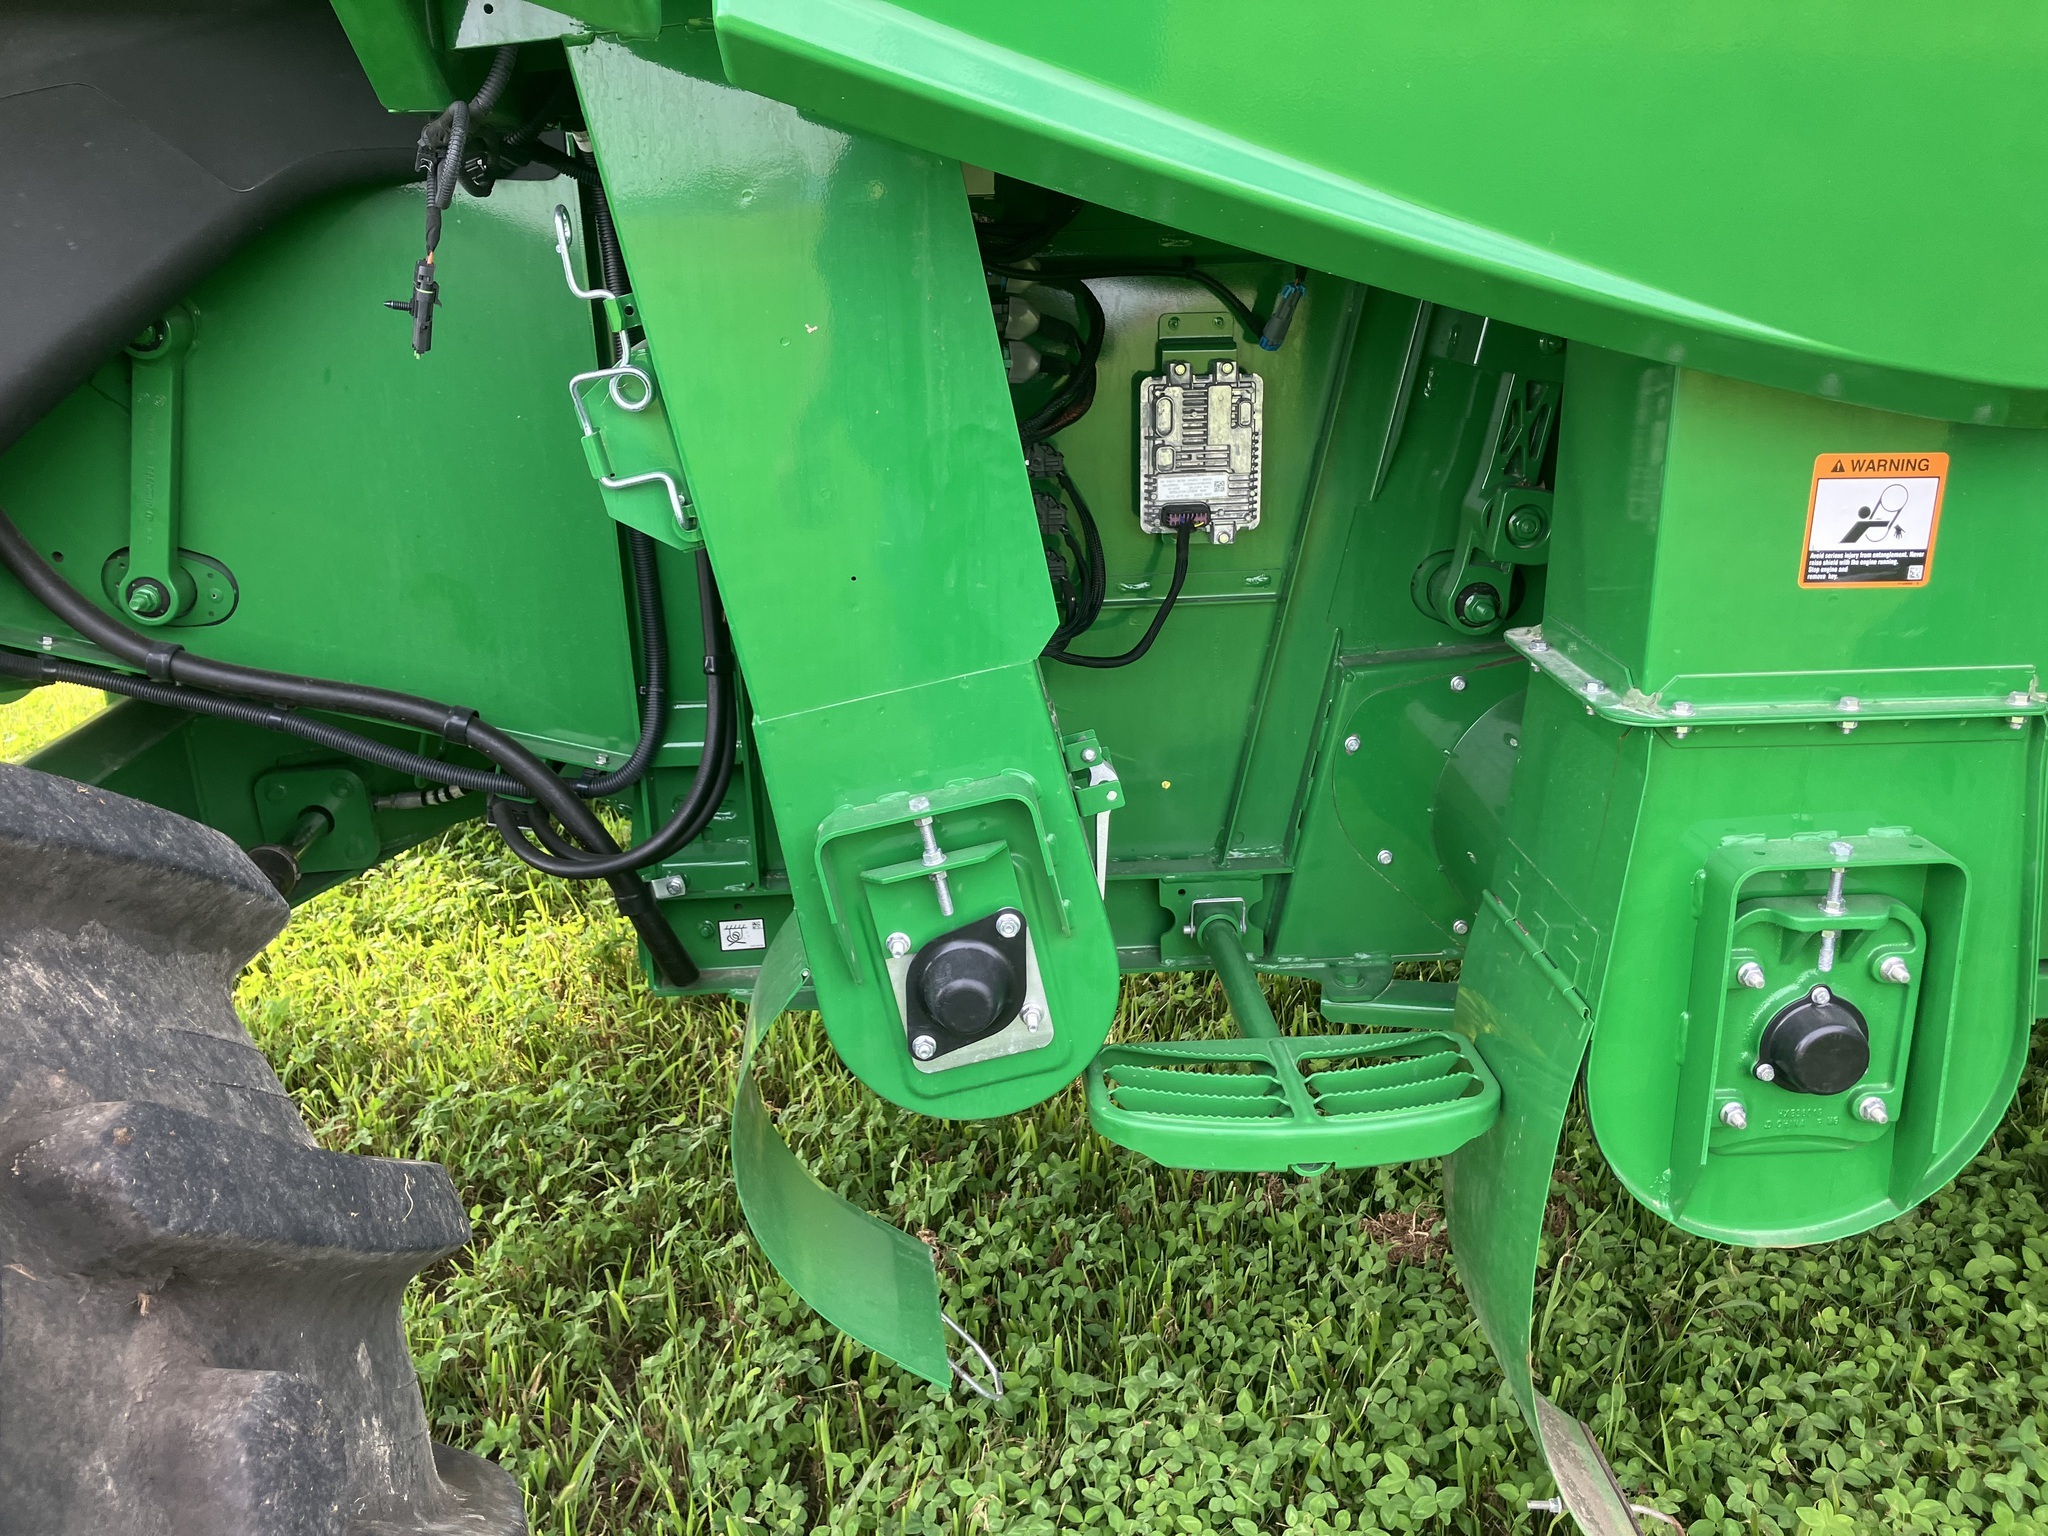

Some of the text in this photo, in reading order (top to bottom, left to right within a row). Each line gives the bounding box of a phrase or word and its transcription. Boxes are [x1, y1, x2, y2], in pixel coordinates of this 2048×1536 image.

[1851, 458, 1930, 472] WARNING
[1820, 566, 1838, 574] engine
[1827, 573, 1839, 581] key.
